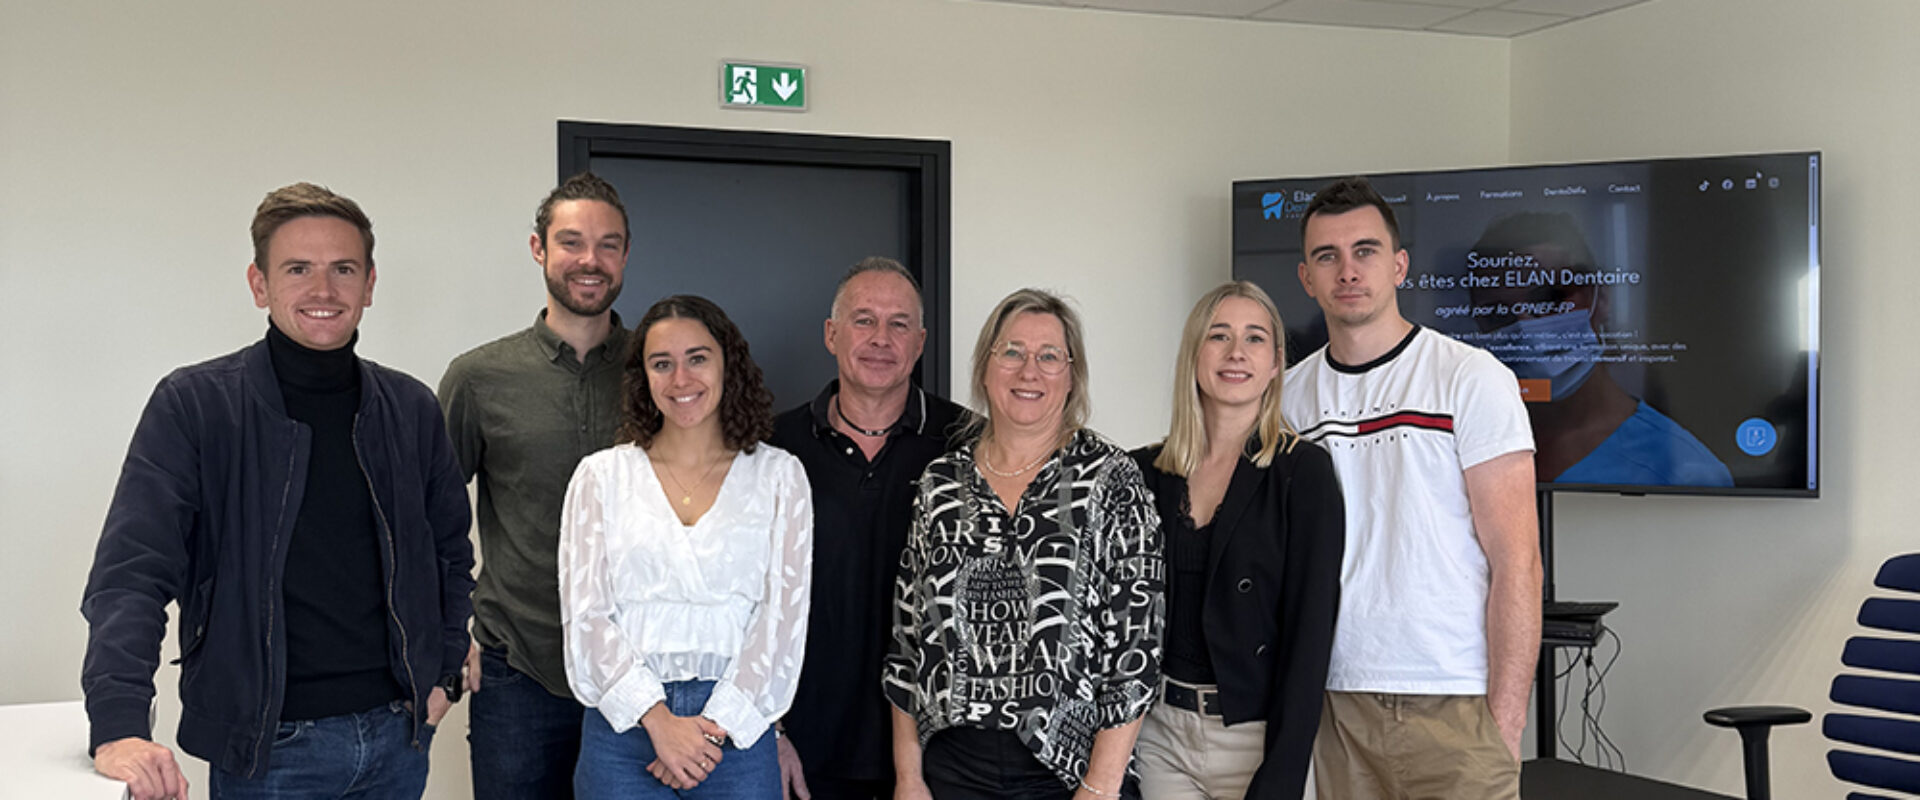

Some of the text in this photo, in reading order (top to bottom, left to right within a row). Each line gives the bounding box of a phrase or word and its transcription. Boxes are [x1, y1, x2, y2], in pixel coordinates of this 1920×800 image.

[1418, 273, 1456, 289] êtes
[1460, 270, 1501, 288] chez
[1504, 269, 1555, 287] ELAN
[1560, 267, 1641, 285] Dentaire
[1472, 305, 1495, 317] par
[957, 600, 1030, 621] SHOW
[970, 638, 1073, 682] WEAR
